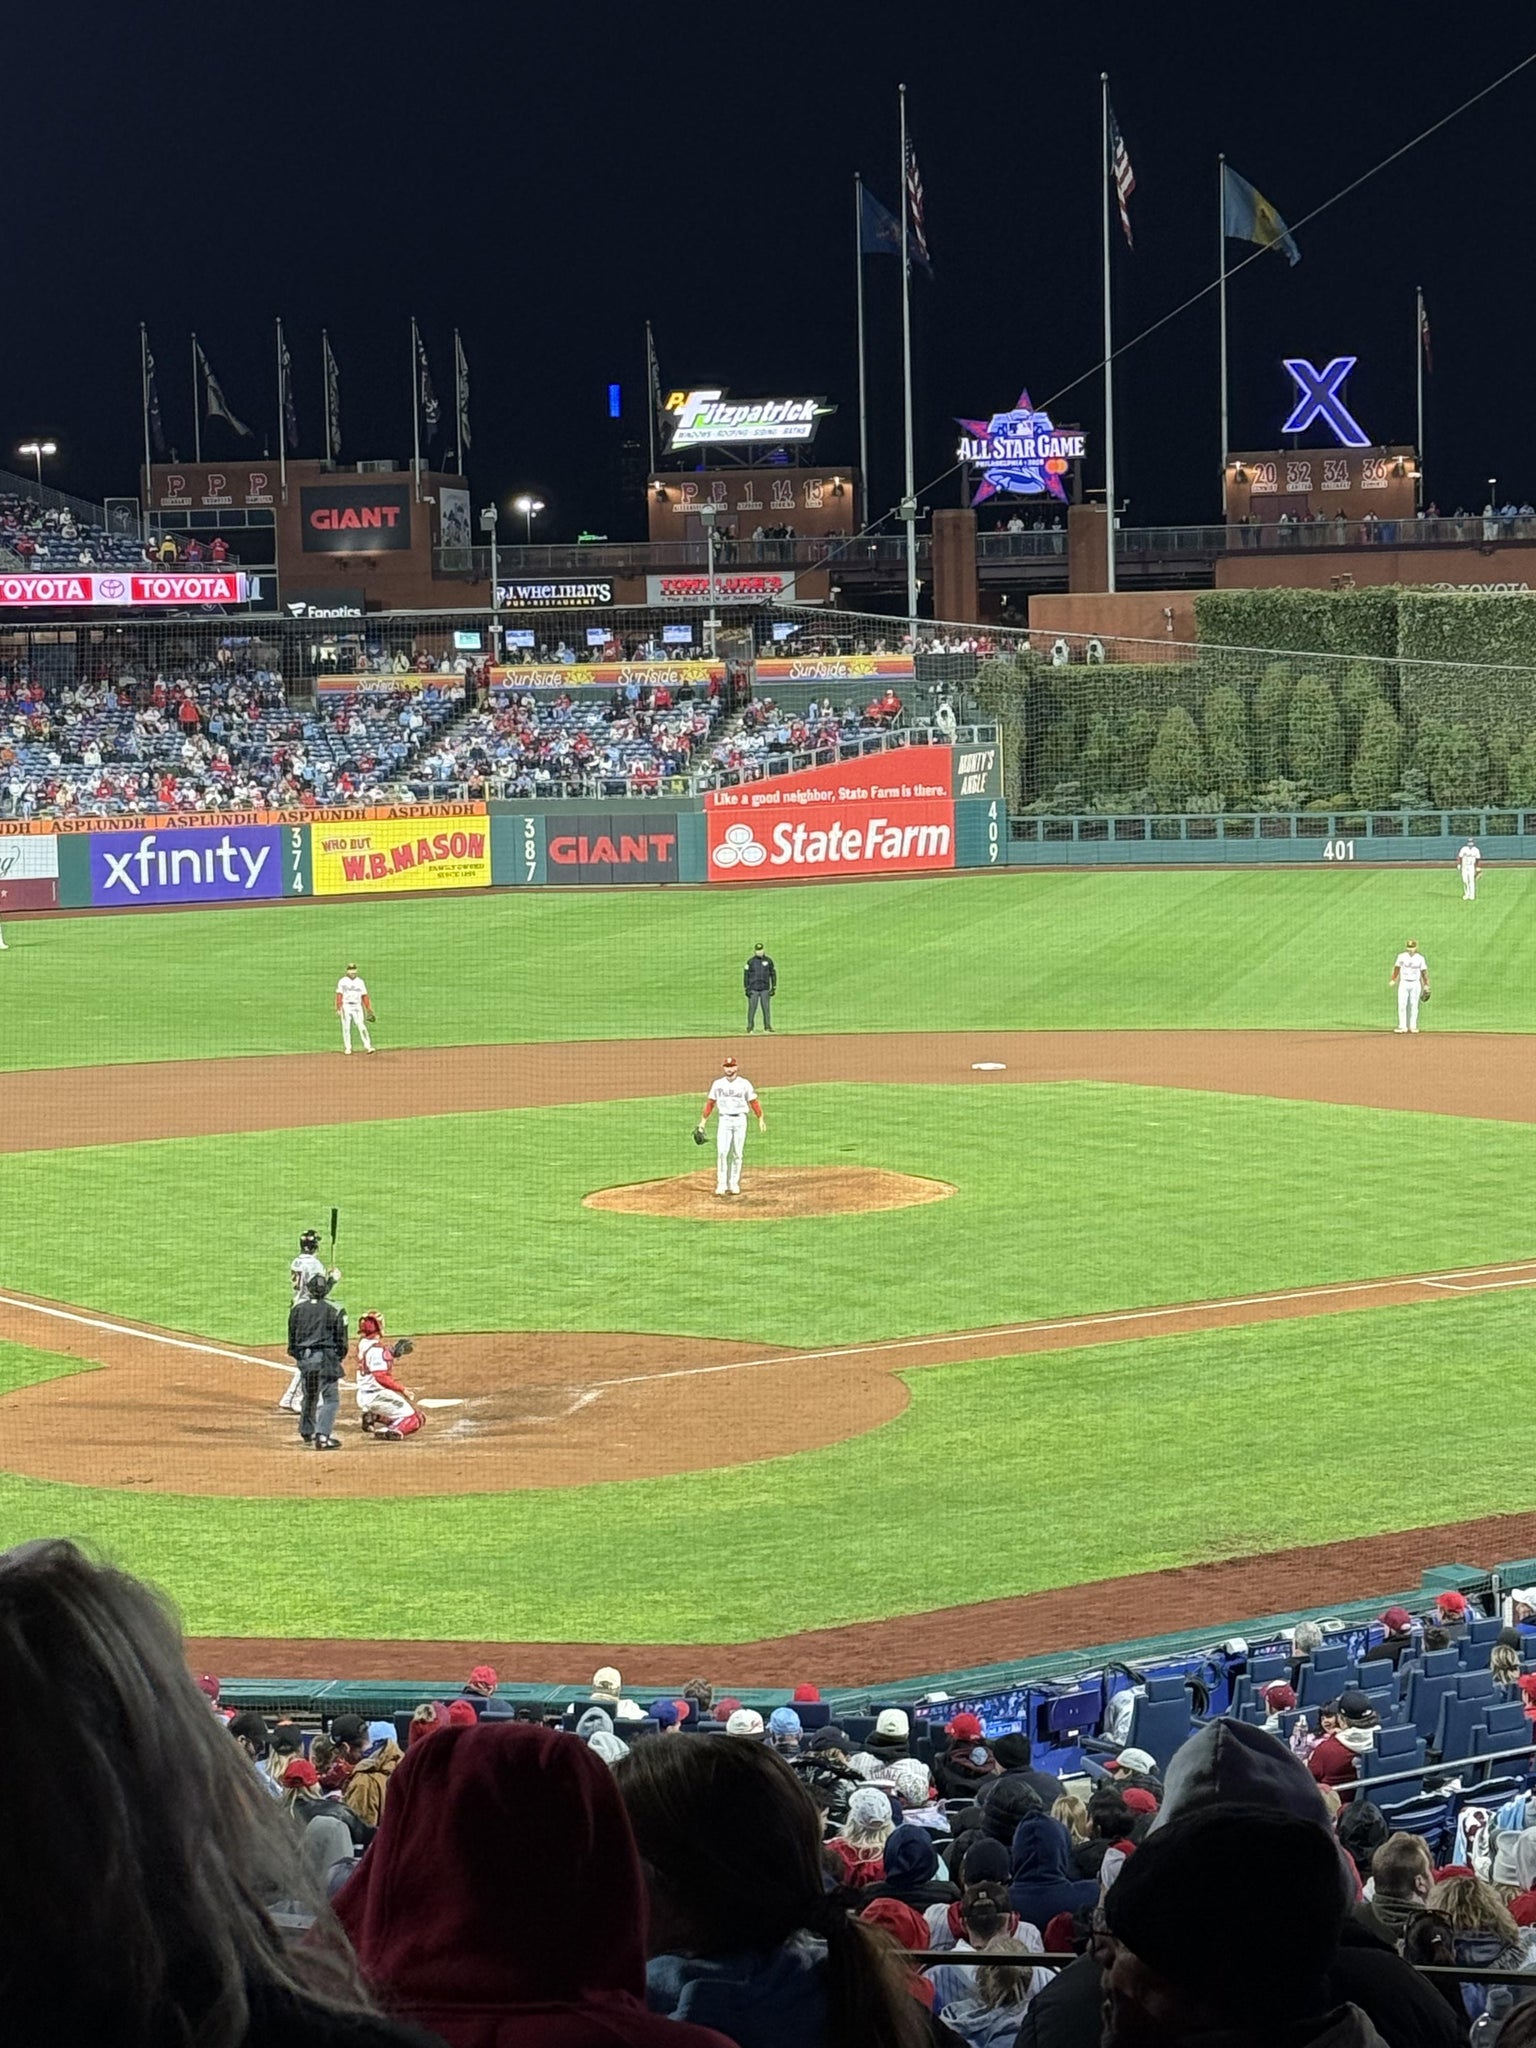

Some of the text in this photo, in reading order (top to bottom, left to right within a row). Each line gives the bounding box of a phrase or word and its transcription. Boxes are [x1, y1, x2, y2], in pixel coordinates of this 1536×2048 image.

[673, 390, 818, 428] Fitzpatrick
[1282, 357, 1371, 446] X
[956, 434, 1085, 460] ALL STAR GAME
[1252, 463, 1278, 485] 20
[1286, 461, 1311, 484] 32
[1324, 460, 1349, 483] 34
[1362, 458, 1387, 481] 36
[310, 506, 400, 530] GIANT
[138, 578, 231, 600] TOYOTA
[1457, 582, 1530, 594] TOYOTA
[307, 605, 361, 618] Fanatics
[502, 669, 562, 689] Surfside
[789, 660, 847, 679] Surfside
[714, 784, 947, 807] Like a good neighbor, State Farm is there.
[165, 813, 258, 829] ASPLUNDH
[277, 809, 367, 823] ASPLUNDH
[387, 804, 475, 819] ASPLUNDH
[50, 817, 147, 833] ASPLUNDH
[322, 837, 371, 852] WHO BUT
[549, 834, 675, 864] GIANT
[1322, 840, 1354, 861] 401
[103, 834, 271, 895] xfinity
